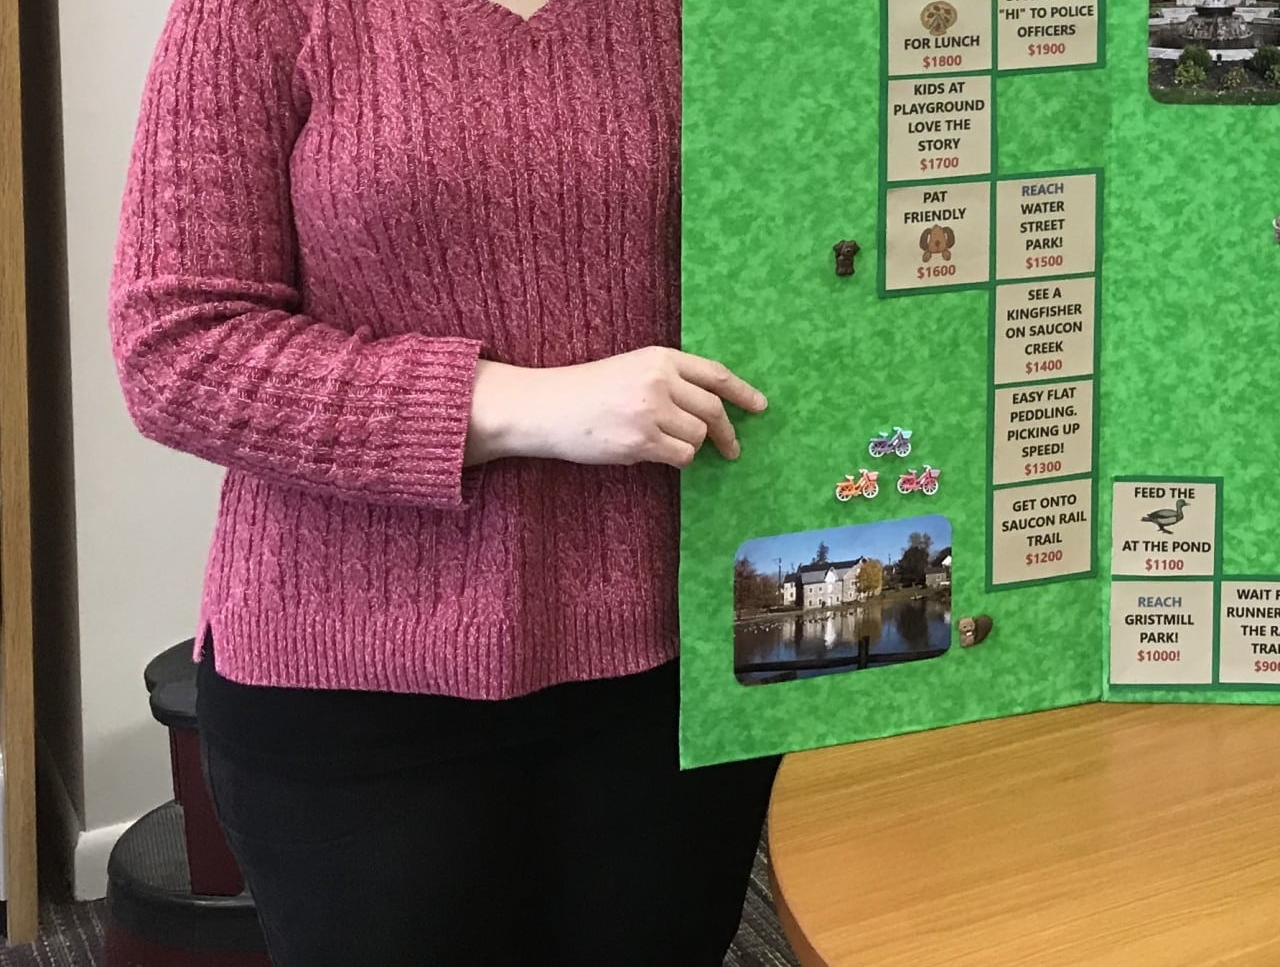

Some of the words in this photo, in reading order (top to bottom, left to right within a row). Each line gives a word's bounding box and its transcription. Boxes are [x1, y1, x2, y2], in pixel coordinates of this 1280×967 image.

[905, 38, 930, 50] FOR
[935, 36, 979, 48] LUNCH
[923, 55, 962, 68] $1800
[1022, 183, 1063, 196] REACH
[924, 191, 947, 203] PAT
[1021, 201, 1064, 214] WATER
[904, 208, 966, 224] FRIENDLY
[1021, 219, 1065, 233] STREET
[1026, 237, 1062, 250] PARK!
[1026, 255, 1063, 269] $1500
[918, 265, 956, 279] $1600
[1138, 597, 1181, 607] REACH
[1125, 615, 1194, 625] GRISTMILL
[1140, 633, 1178, 643] PARK!
[1138, 650, 1180, 662] $1000!
